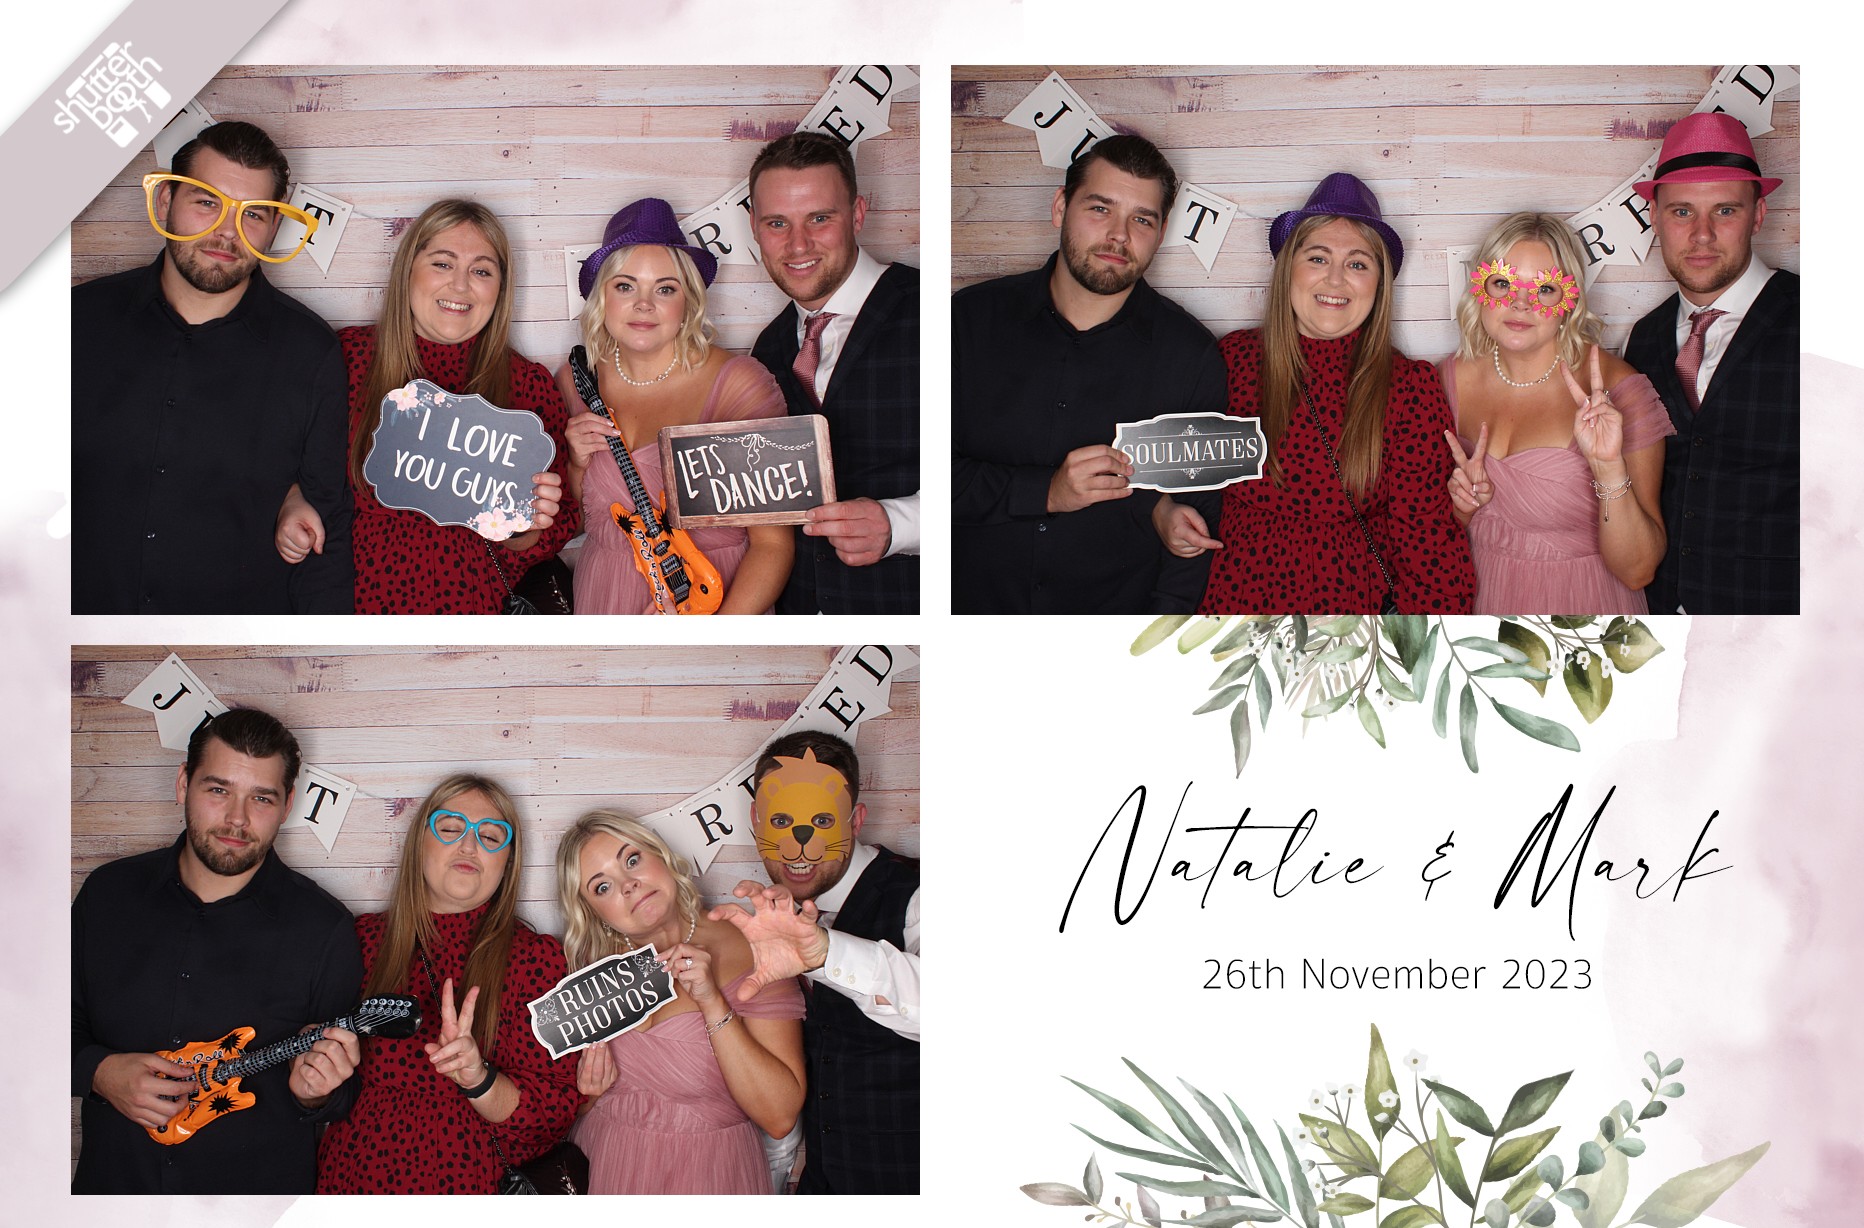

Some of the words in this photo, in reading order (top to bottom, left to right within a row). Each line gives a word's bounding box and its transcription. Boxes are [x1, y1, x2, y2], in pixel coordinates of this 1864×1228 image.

[418, 408, 431, 441] I
[447, 417, 523, 467] LOVE
[1121, 437, 1259, 465] SOULMATES
[394, 449, 446, 490] YOU
[451, 467, 518, 513] GUYS
[677, 443, 726, 499] LETS
[709, 460, 813, 514] DANCE!
[556, 960, 636, 1016] RUINS
[556, 980, 659, 1047] PHOTOS
